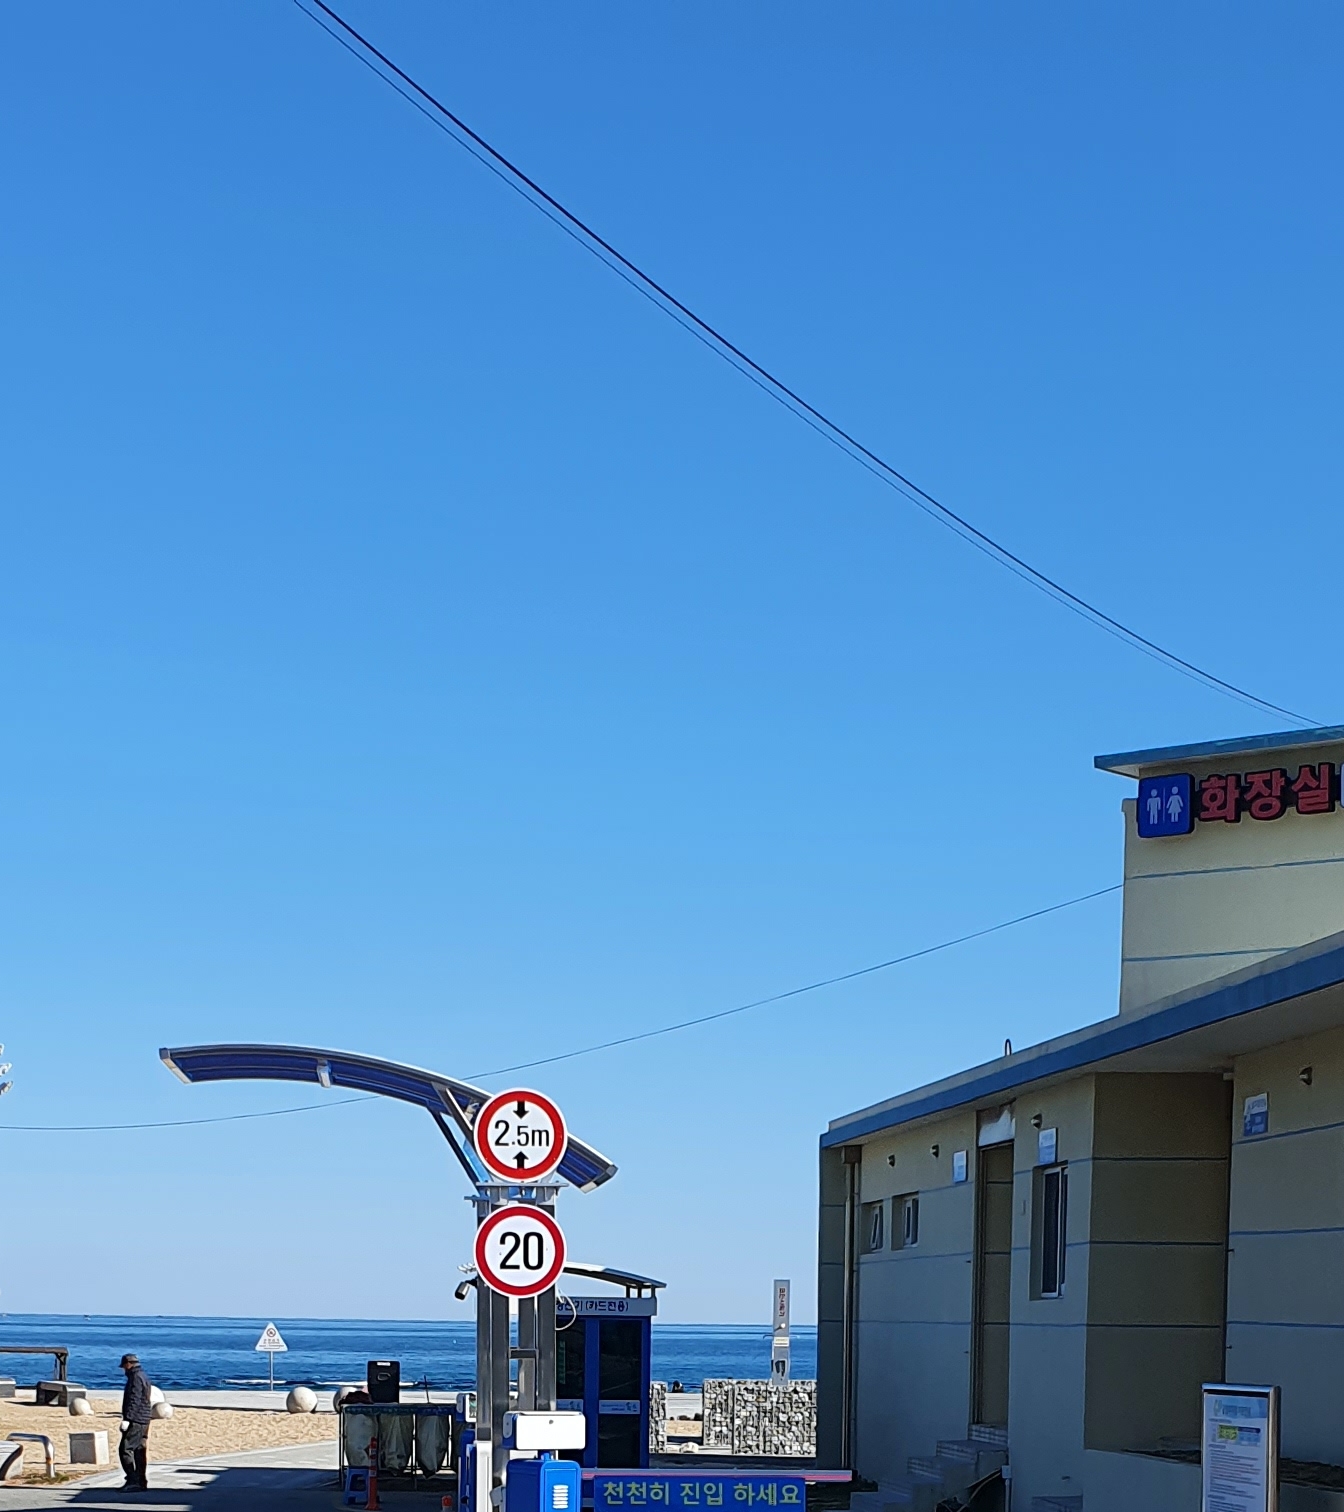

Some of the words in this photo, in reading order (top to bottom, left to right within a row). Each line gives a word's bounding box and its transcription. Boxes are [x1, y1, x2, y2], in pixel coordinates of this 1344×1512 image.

[1199, 763, 1330, 821] 화장실
[494, 1119, 550, 1147] 2.5m
[499, 1231, 544, 1270] 20
[603, 1481, 670, 1506] 천천히
[680, 1482, 723, 1506] 진입
[733, 1482, 802, 1507] 하세요
